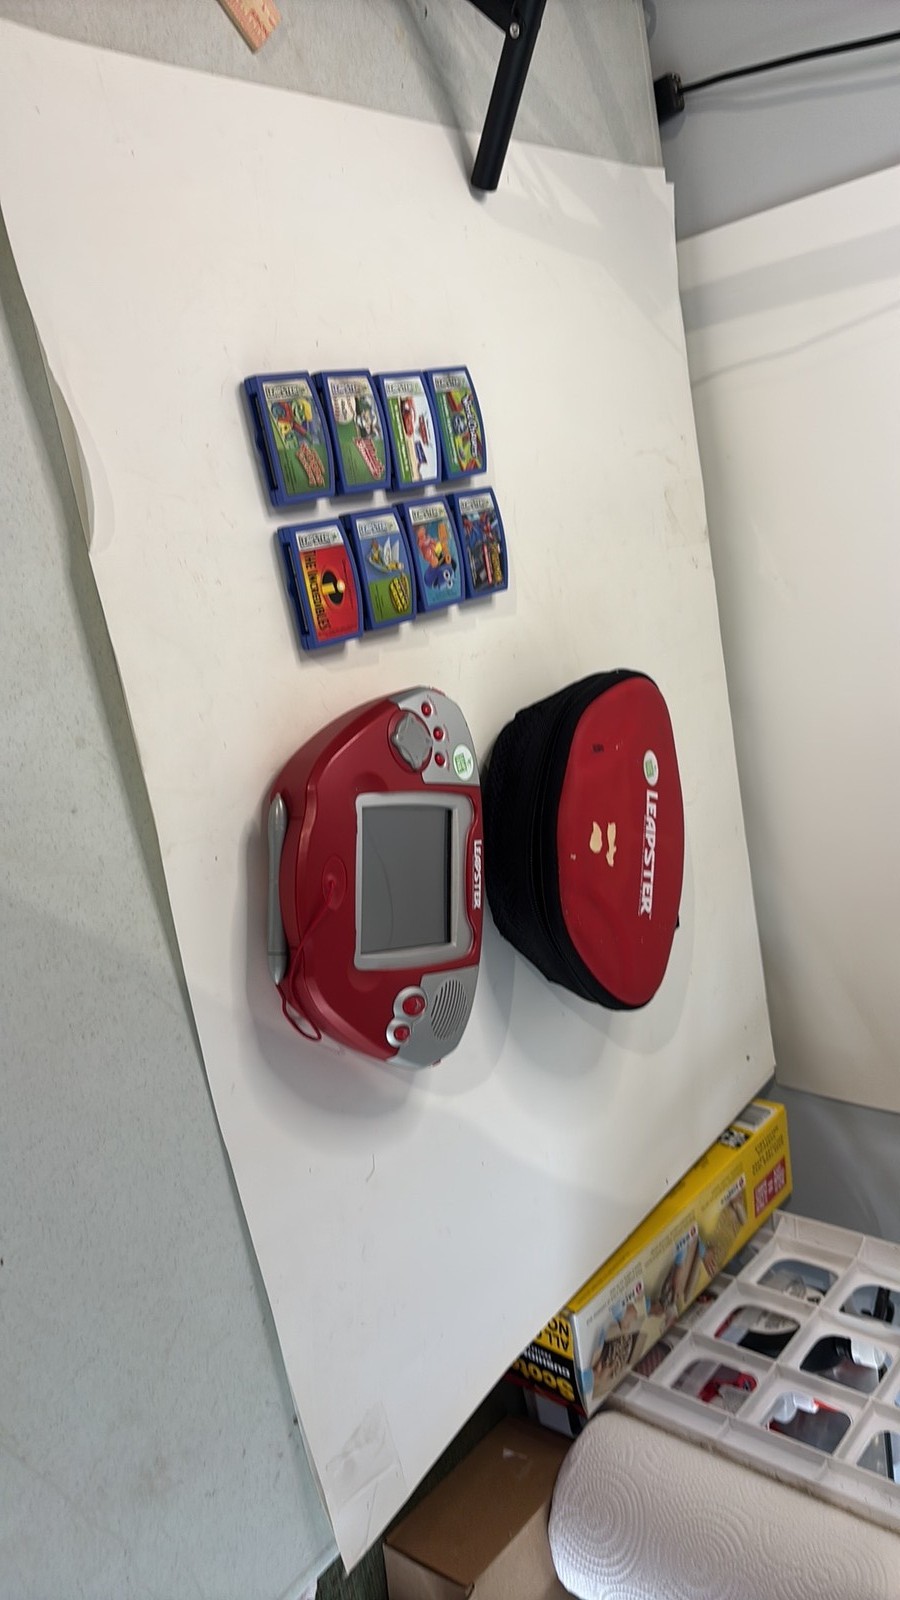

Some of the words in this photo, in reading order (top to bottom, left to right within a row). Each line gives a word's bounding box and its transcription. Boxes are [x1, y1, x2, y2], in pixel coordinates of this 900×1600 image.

[304, 550, 317, 570] THE
[308, 569, 331, 631] INCREDIBLES
[471, 839, 482, 910] LEAPSTER
[640, 789, 658, 915] LEAPSTER
